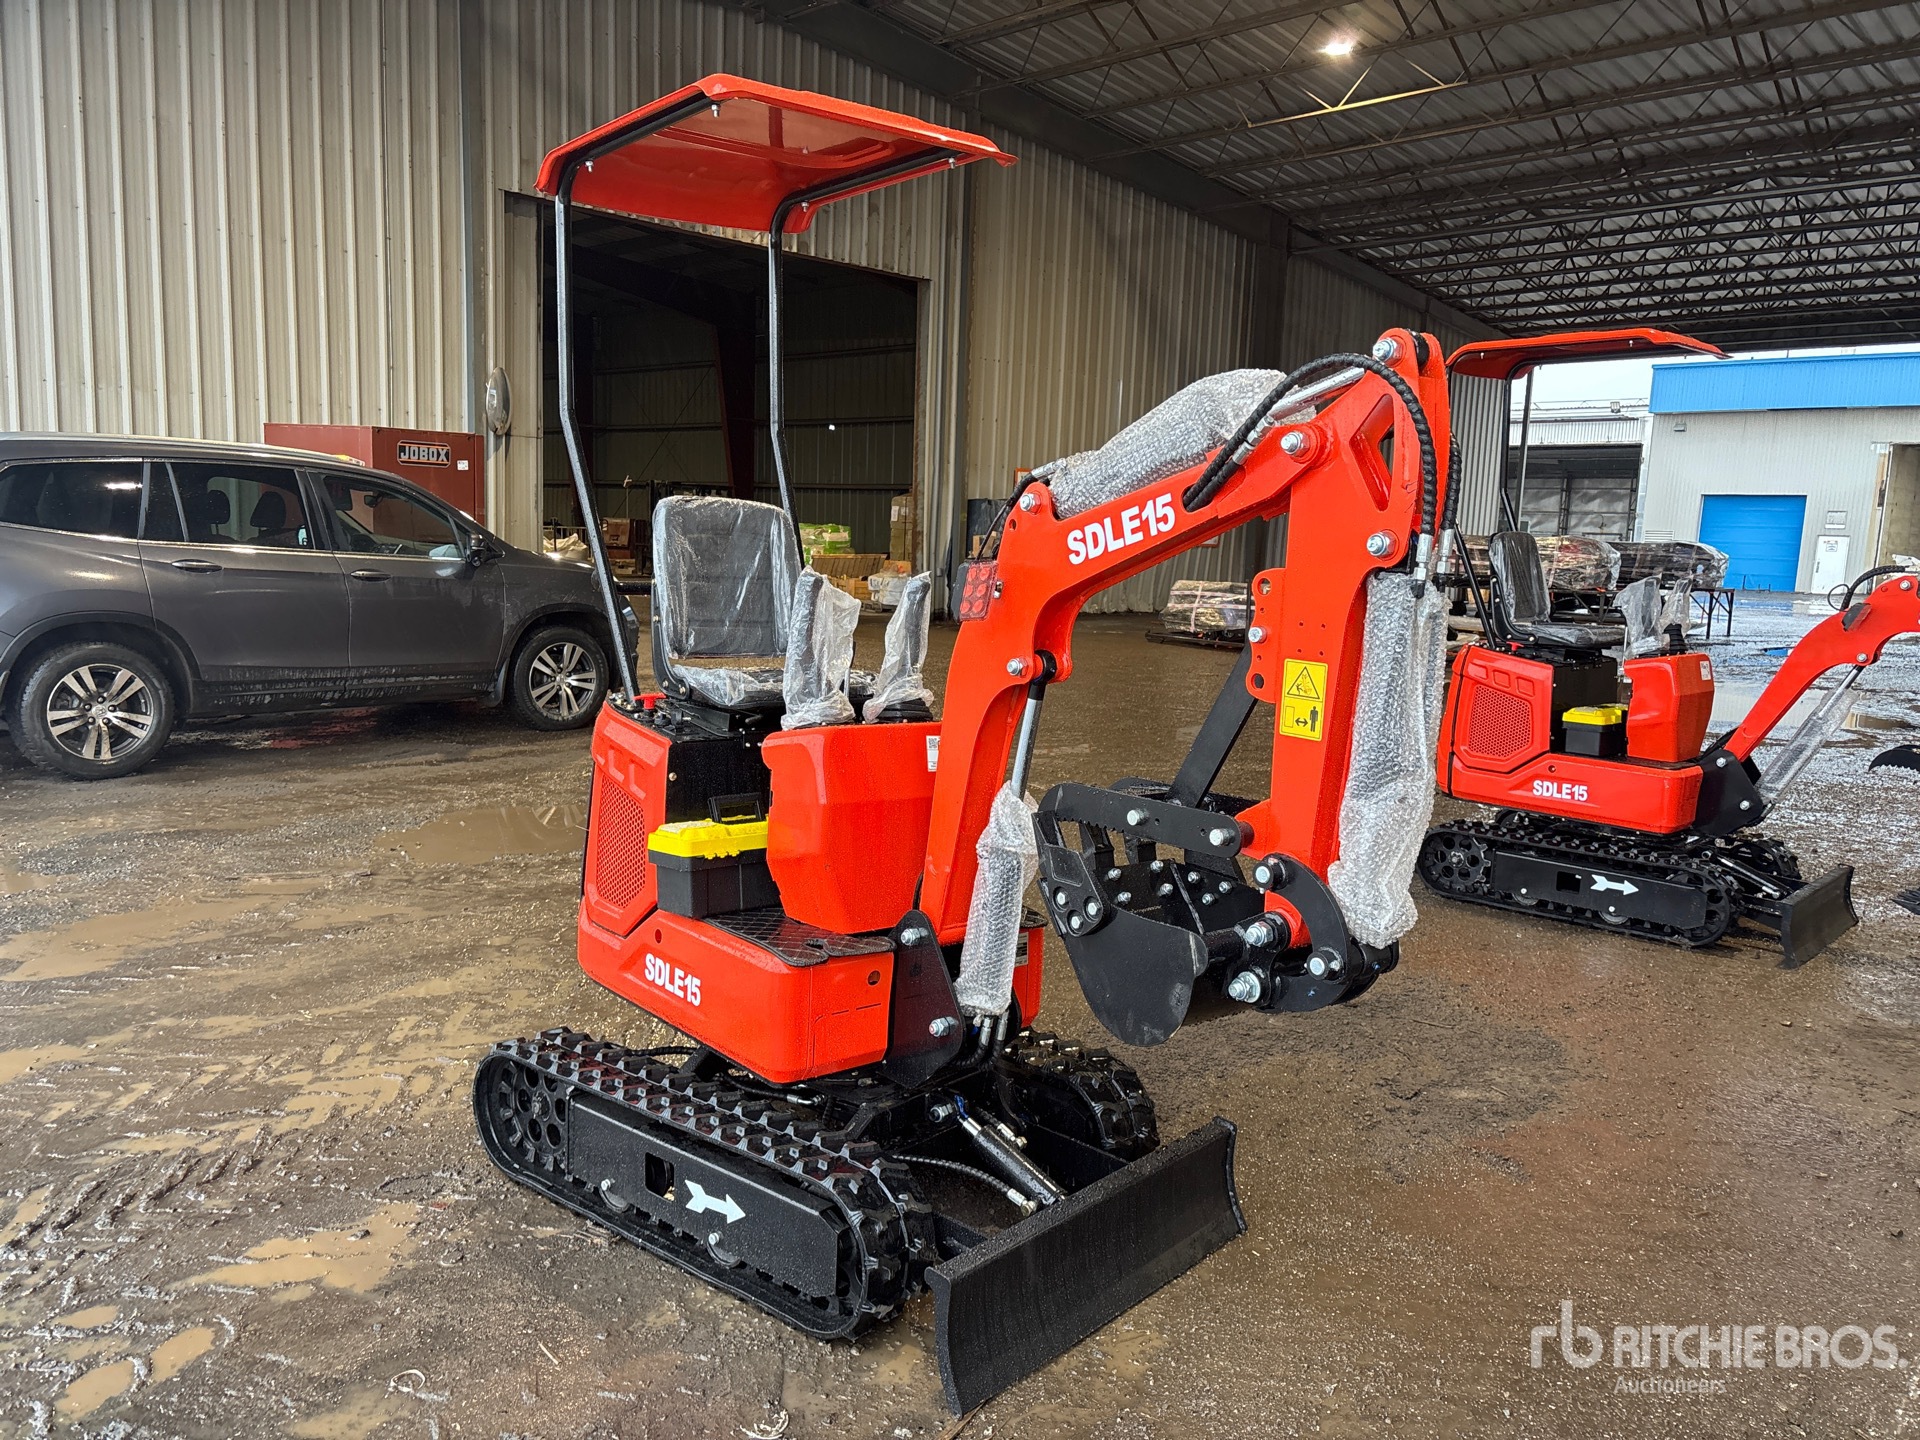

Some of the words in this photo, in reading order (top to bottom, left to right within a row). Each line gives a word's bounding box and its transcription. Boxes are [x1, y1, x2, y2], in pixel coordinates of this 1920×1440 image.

[400, 445, 448, 462] JOBOX
[1067, 492, 1176, 565] SDLE15
[1532, 779, 1588, 802] SDLE15
[644, 952, 701, 1007] SDLE15
